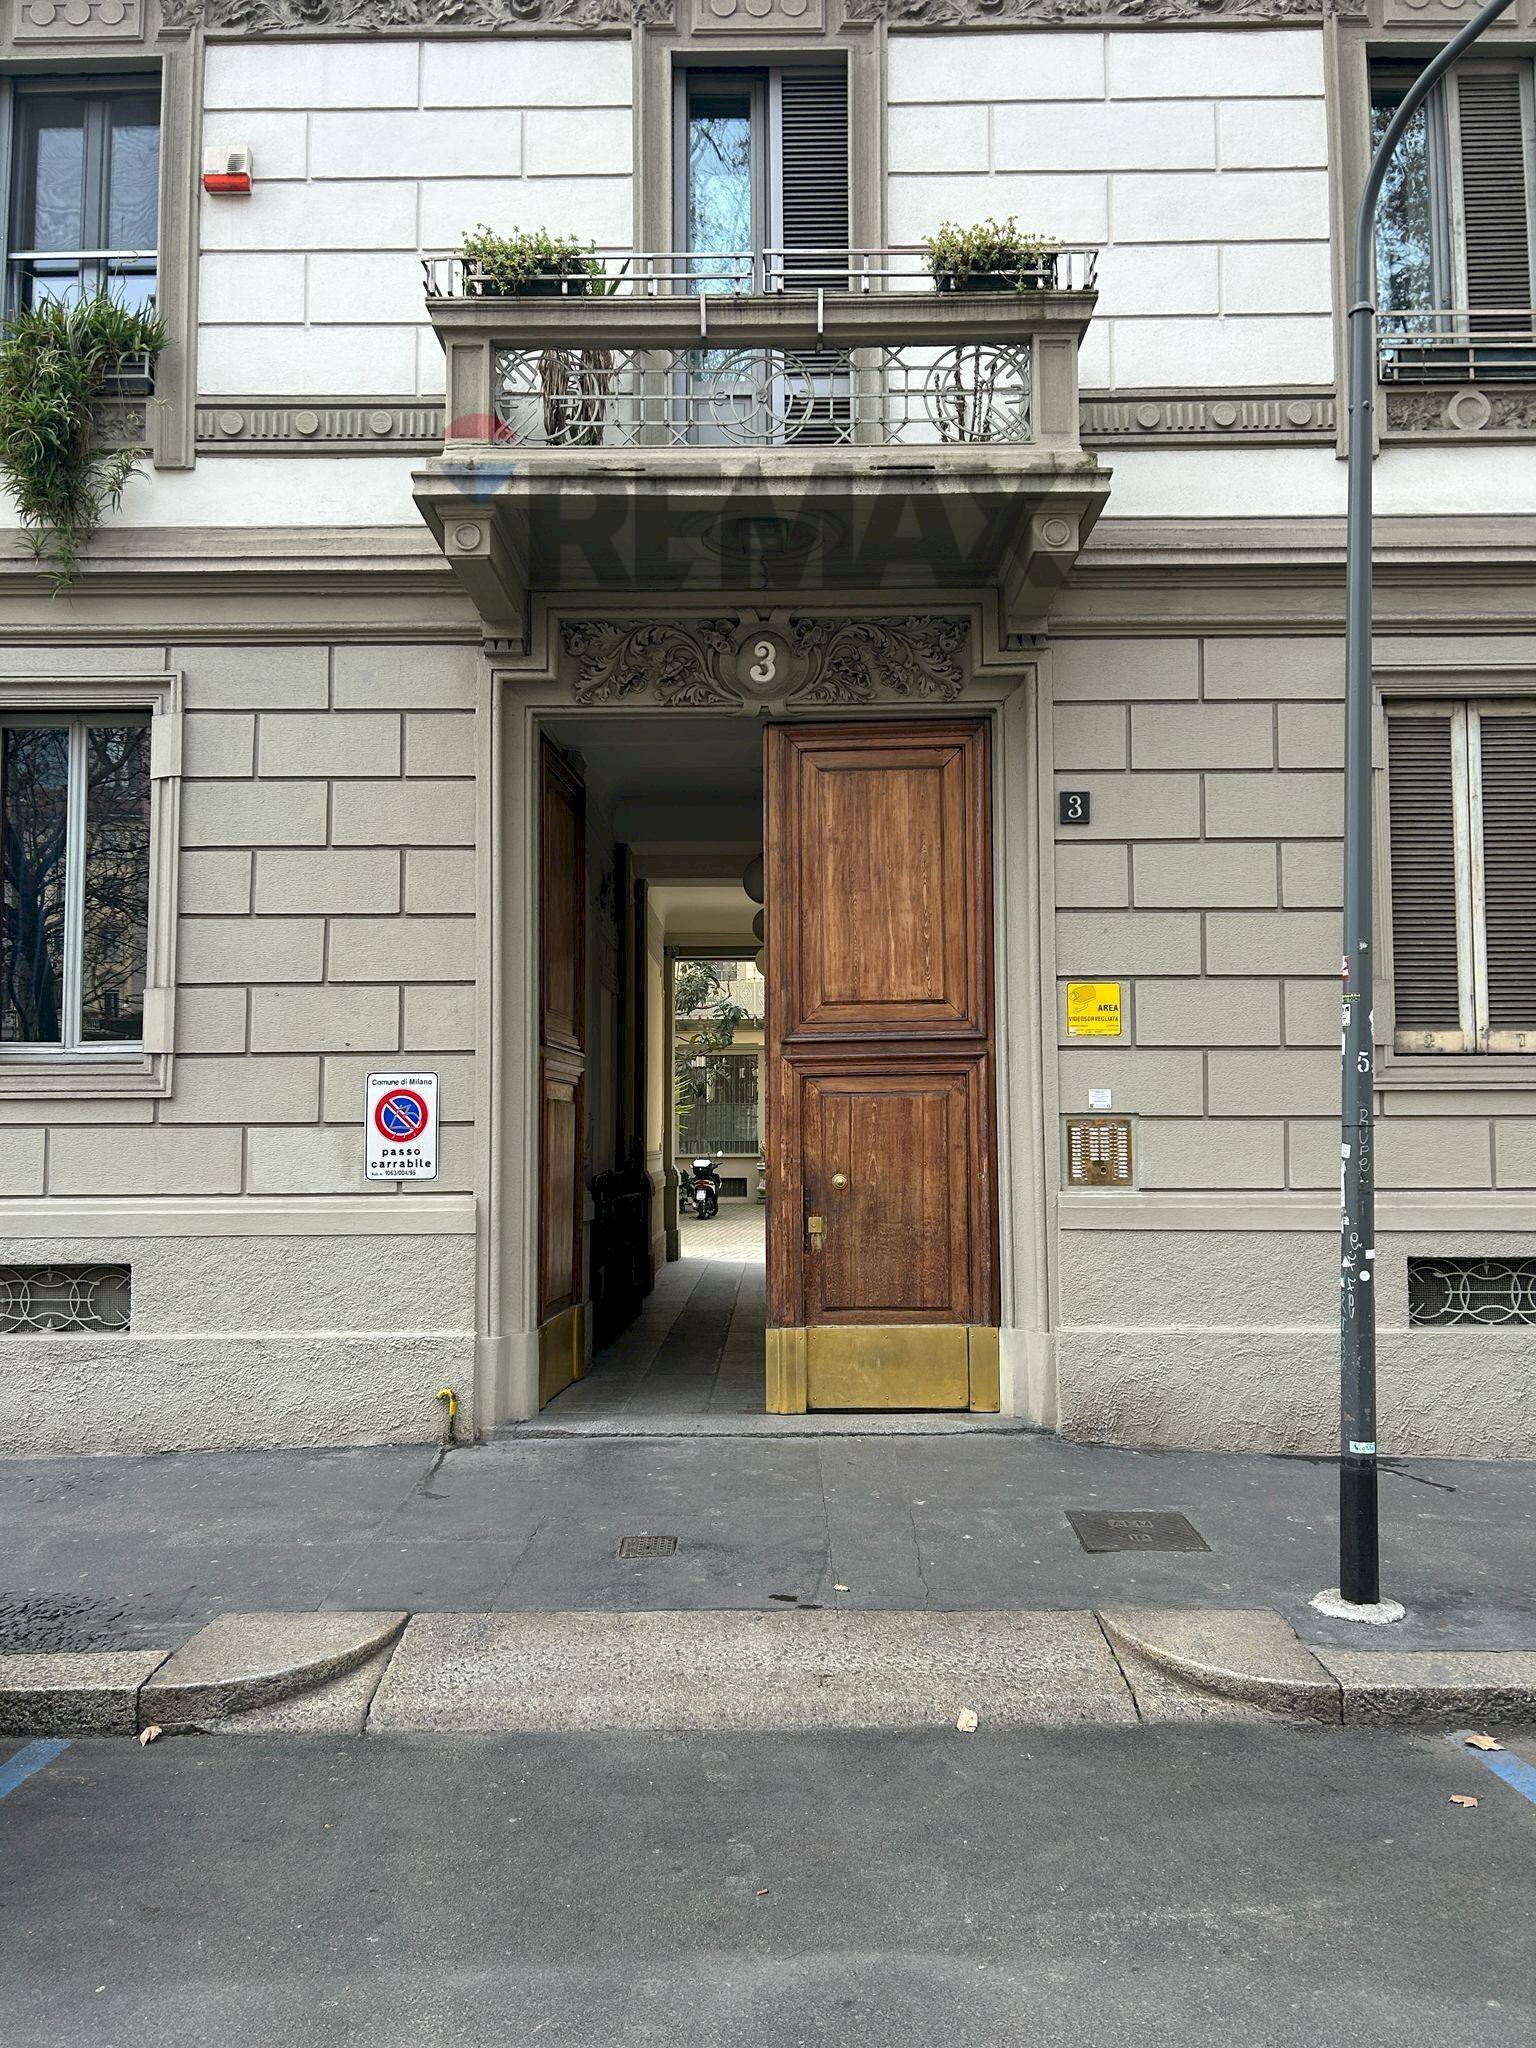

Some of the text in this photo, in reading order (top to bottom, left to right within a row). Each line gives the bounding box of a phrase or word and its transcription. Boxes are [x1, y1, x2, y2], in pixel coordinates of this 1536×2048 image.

[750, 641, 776, 682] 3
[1068, 795, 1082, 818] 3
[1098, 1004, 1119, 1012] AREA
[1357, 1051, 1370, 1073] 5
[382, 1148, 421, 1157] passo
[371, 1159, 431, 1168] carrabile
